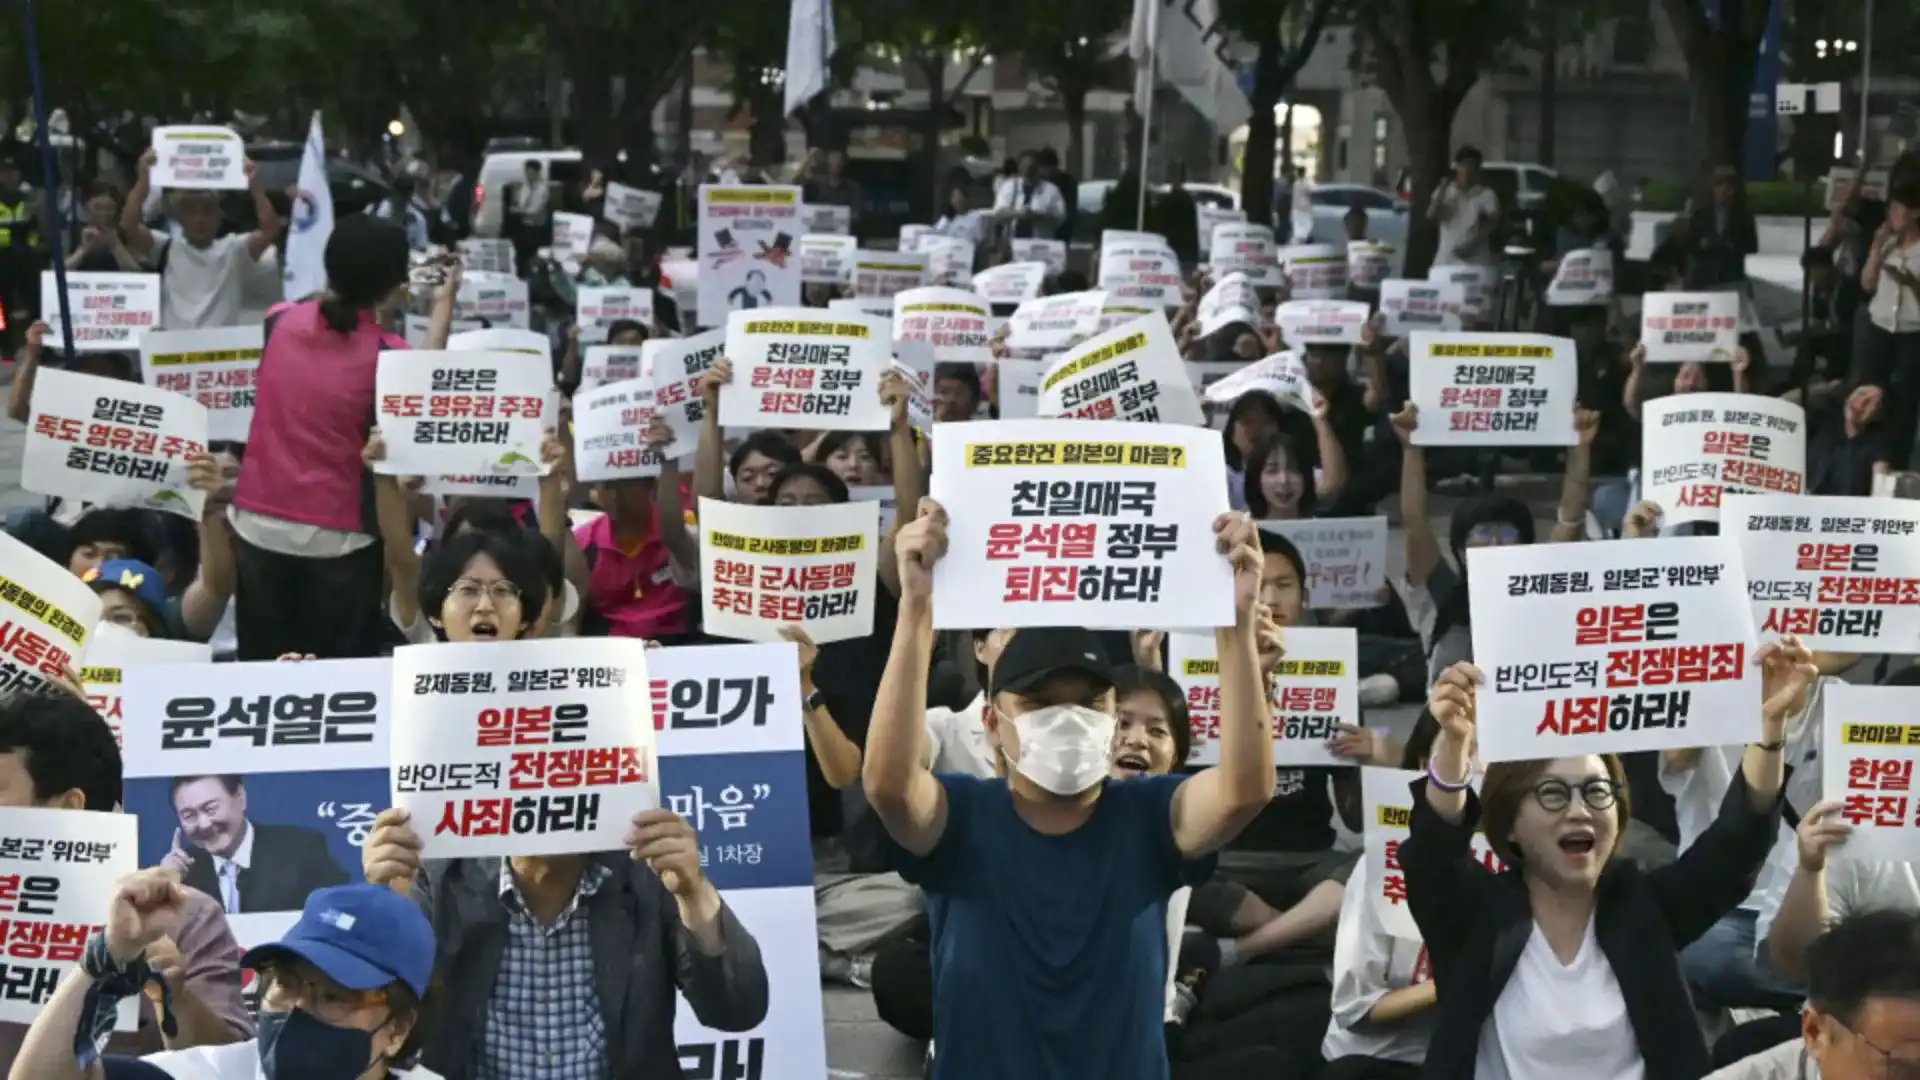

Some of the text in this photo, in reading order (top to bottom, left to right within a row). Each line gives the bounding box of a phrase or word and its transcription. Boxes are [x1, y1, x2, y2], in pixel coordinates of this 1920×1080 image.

[766, 343, 851, 366] 친일매국
[431, 368, 498, 391] 일본은
[751, 367, 862, 391] 윤석열 정부
[1060, 360, 1139, 409] 친일매국
[1454, 365, 1535, 386] 친일매국
[382, 394, 543, 418] 독도 영유권 주장
[759, 392, 851, 416] 퇴진하라!
[1118, 380, 1160, 411] 정부
[1440, 388, 1548, 408] 윤석열 정부
[92, 396, 164, 429] 일본은
[1449, 411, 1539, 432] 퇴진하라!
[35, 413, 84, 443] 독도
[86, 424, 159, 457] 영유권
[414, 421, 510, 444] 중단하라!
[1702, 431, 1772, 461] 일본은
[65, 446, 170, 483] 중단하라!
[972, 443, 1183, 467] 중요한건 일본의 마음?
[1722, 459, 1803, 494] 전쟁범죄
[1011, 480, 1156, 517] 친일매국
[986, 523, 1179, 560] 윤석열 정부
[1796, 543, 1879, 572] 일본은
[714, 559, 856, 592] 한일 군사동맹
[1003, 565, 1162, 602] 퇴진하라!
[1508, 571, 1594, 596] 강제동원,
[712, 587, 859, 621] 추진 중단하라!
[1575, 602, 1679, 645] 일본은
[1761, 607, 1883, 637] 사죄하라!
[414, 672, 497, 695] 강제동원,
[1496, 643, 1745, 693] 반인도적 전쟁범죄
[161, 691, 377, 750] 윤석열은
[477, 703, 588, 746] 일본은
[1536, 690, 1691, 736] 사죄하라!
[1848, 725, 1903, 743] 한미일
[397, 746, 648, 792] 반인도적 전쟁범죄
[1848, 757, 1913, 790] 한일
[434, 793, 600, 837] 사죄하라!
[1842, 794, 1908, 826] 추진
[715, 843, 763, 865] 1차장
